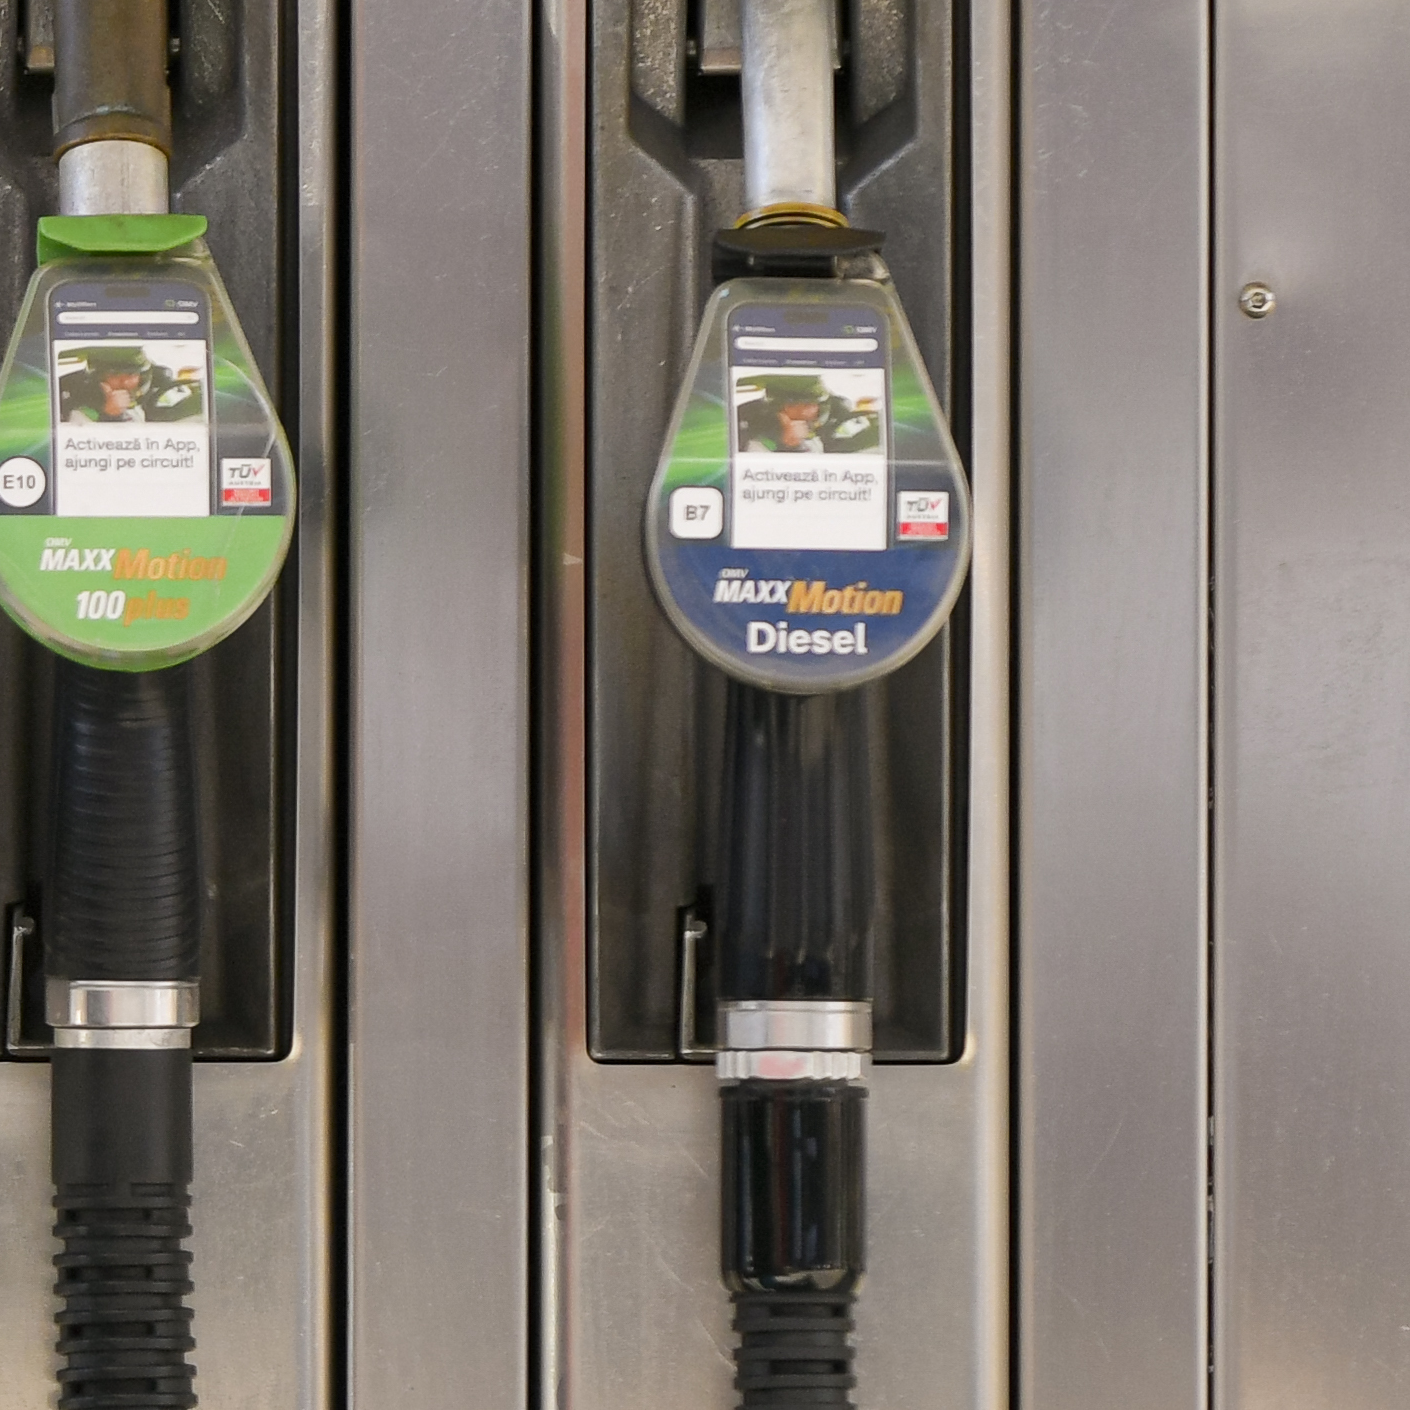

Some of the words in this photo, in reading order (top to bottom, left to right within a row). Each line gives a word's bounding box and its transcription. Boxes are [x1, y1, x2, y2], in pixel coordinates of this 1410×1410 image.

[64, 437, 142, 453] Activează
[163, 437, 201, 457] App,
[64, 455, 113, 471] ajungi
[116, 457, 137, 470] pe
[140, 455, 194, 468] circuit!
[2, 475, 36, 489] E10
[742, 486, 790, 503] ajungi
[793, 488, 814, 502] pe
[818, 488, 872, 502] circuit!
[685, 505, 711, 520] B7
[745, 620, 869, 655] Diesel
